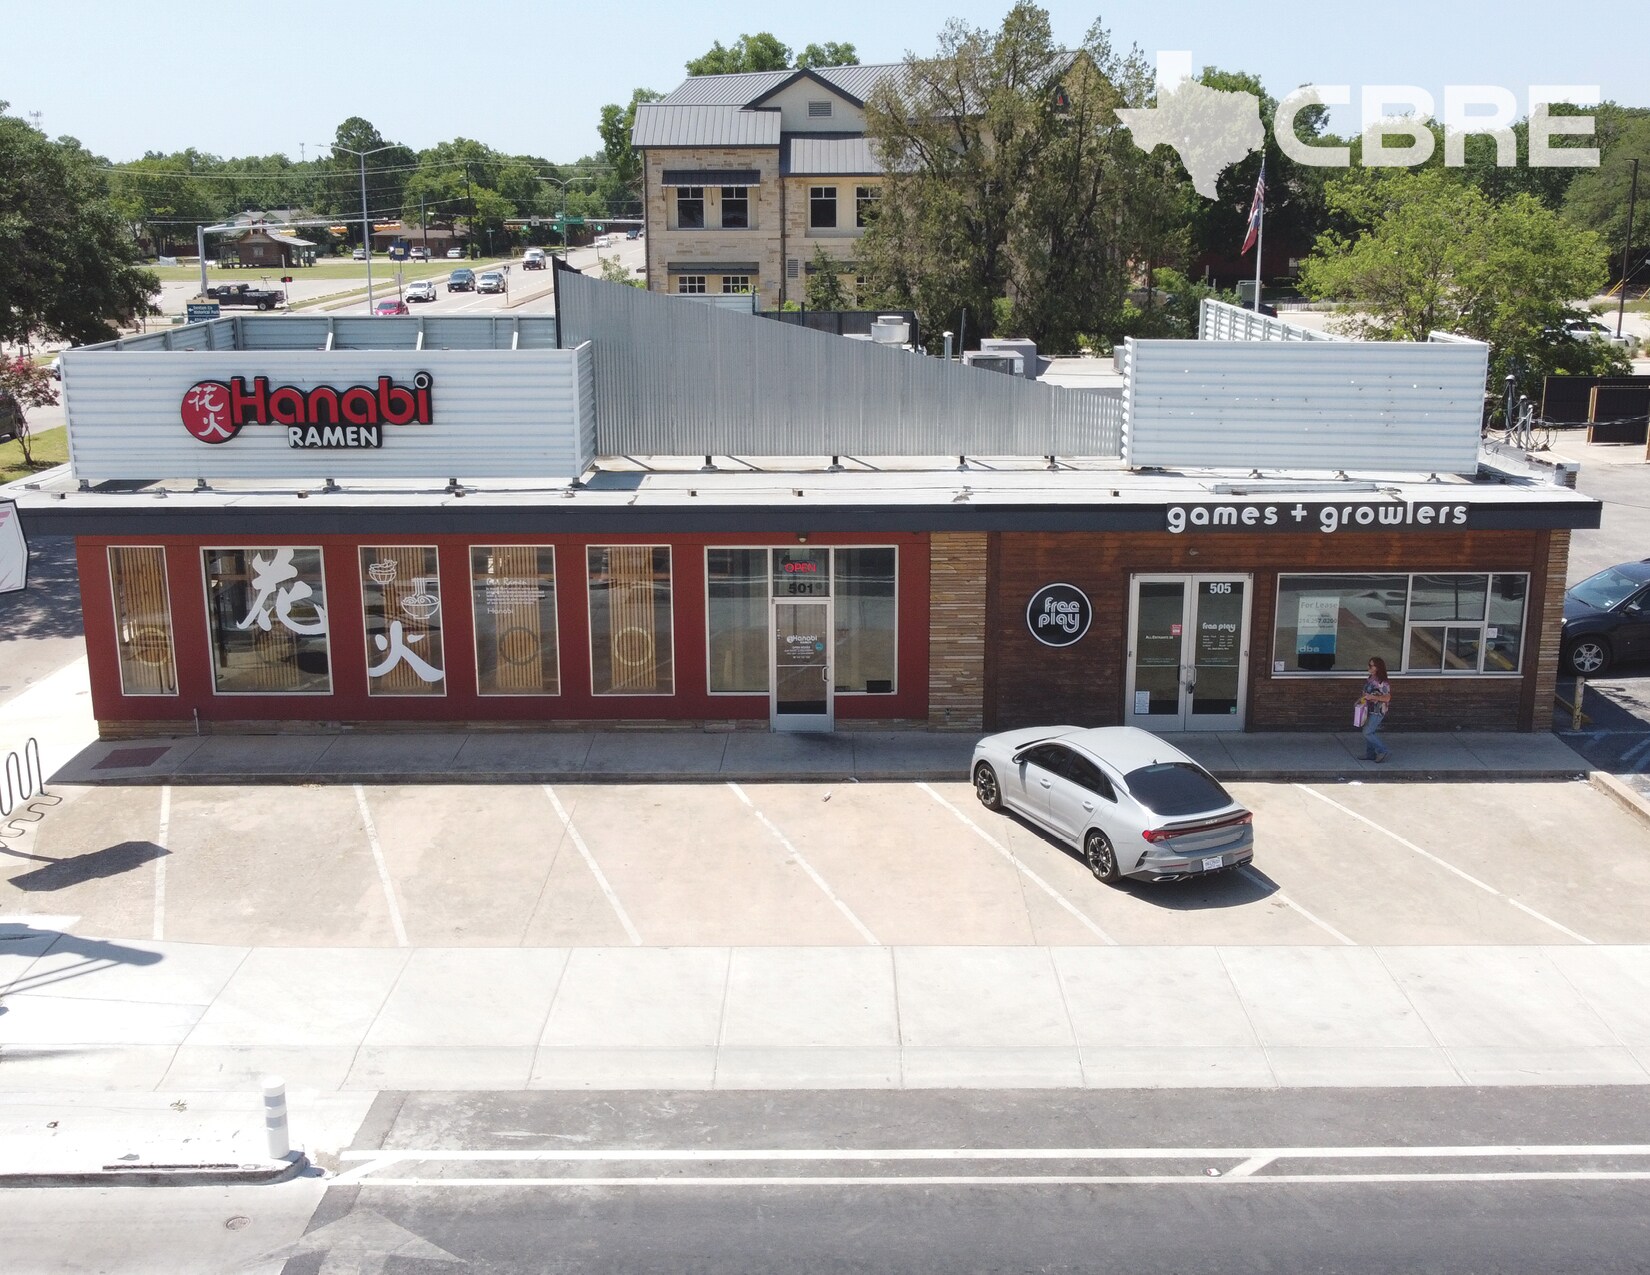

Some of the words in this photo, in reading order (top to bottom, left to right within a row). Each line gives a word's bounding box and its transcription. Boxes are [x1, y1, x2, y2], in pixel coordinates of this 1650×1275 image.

[231, 374, 430, 424] Hanabi
[188, 386, 233, 438] 花火
[288, 426, 378, 447] RAMEN
[1167, 506, 1278, 533] games
[1291, 504, 1307, 522] +
[1319, 501, 1468, 533] growlers
[785, 563, 817, 573] OPEN
[236, 549, 327, 636] 花
[788, 583, 813, 594] 501
[1209, 583, 1232, 594] 505
[487, 607, 514, 615] Hanabi
[1044, 597, 1080, 613] free
[1038, 612, 1080, 634] play
[1202, 622, 1217, 630] free
[1218, 623, 1236, 632] play
[792, 634, 818, 642] Hanabi
[369, 621, 445, 682] 火
[1299, 645, 1320, 653] dba
